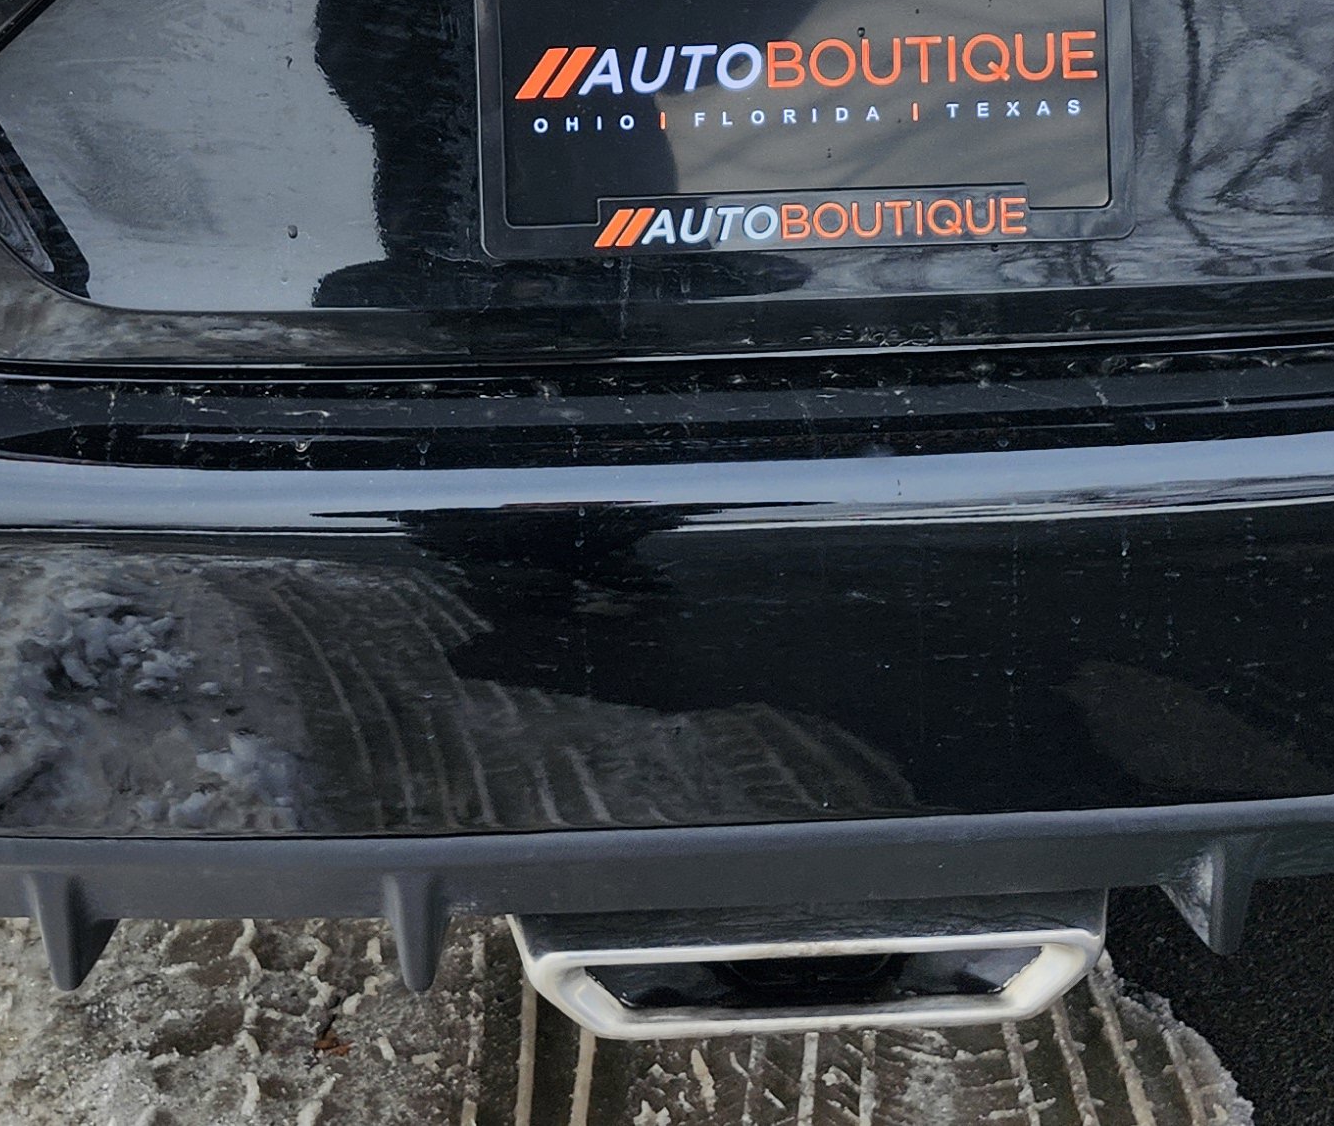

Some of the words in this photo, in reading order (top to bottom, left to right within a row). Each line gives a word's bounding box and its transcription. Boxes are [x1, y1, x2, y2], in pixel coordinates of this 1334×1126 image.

[532, 114, 636, 134] OHIO
[694, 105, 882, 128] FLORIDA
[946, 99, 1082, 121] TEXAS
